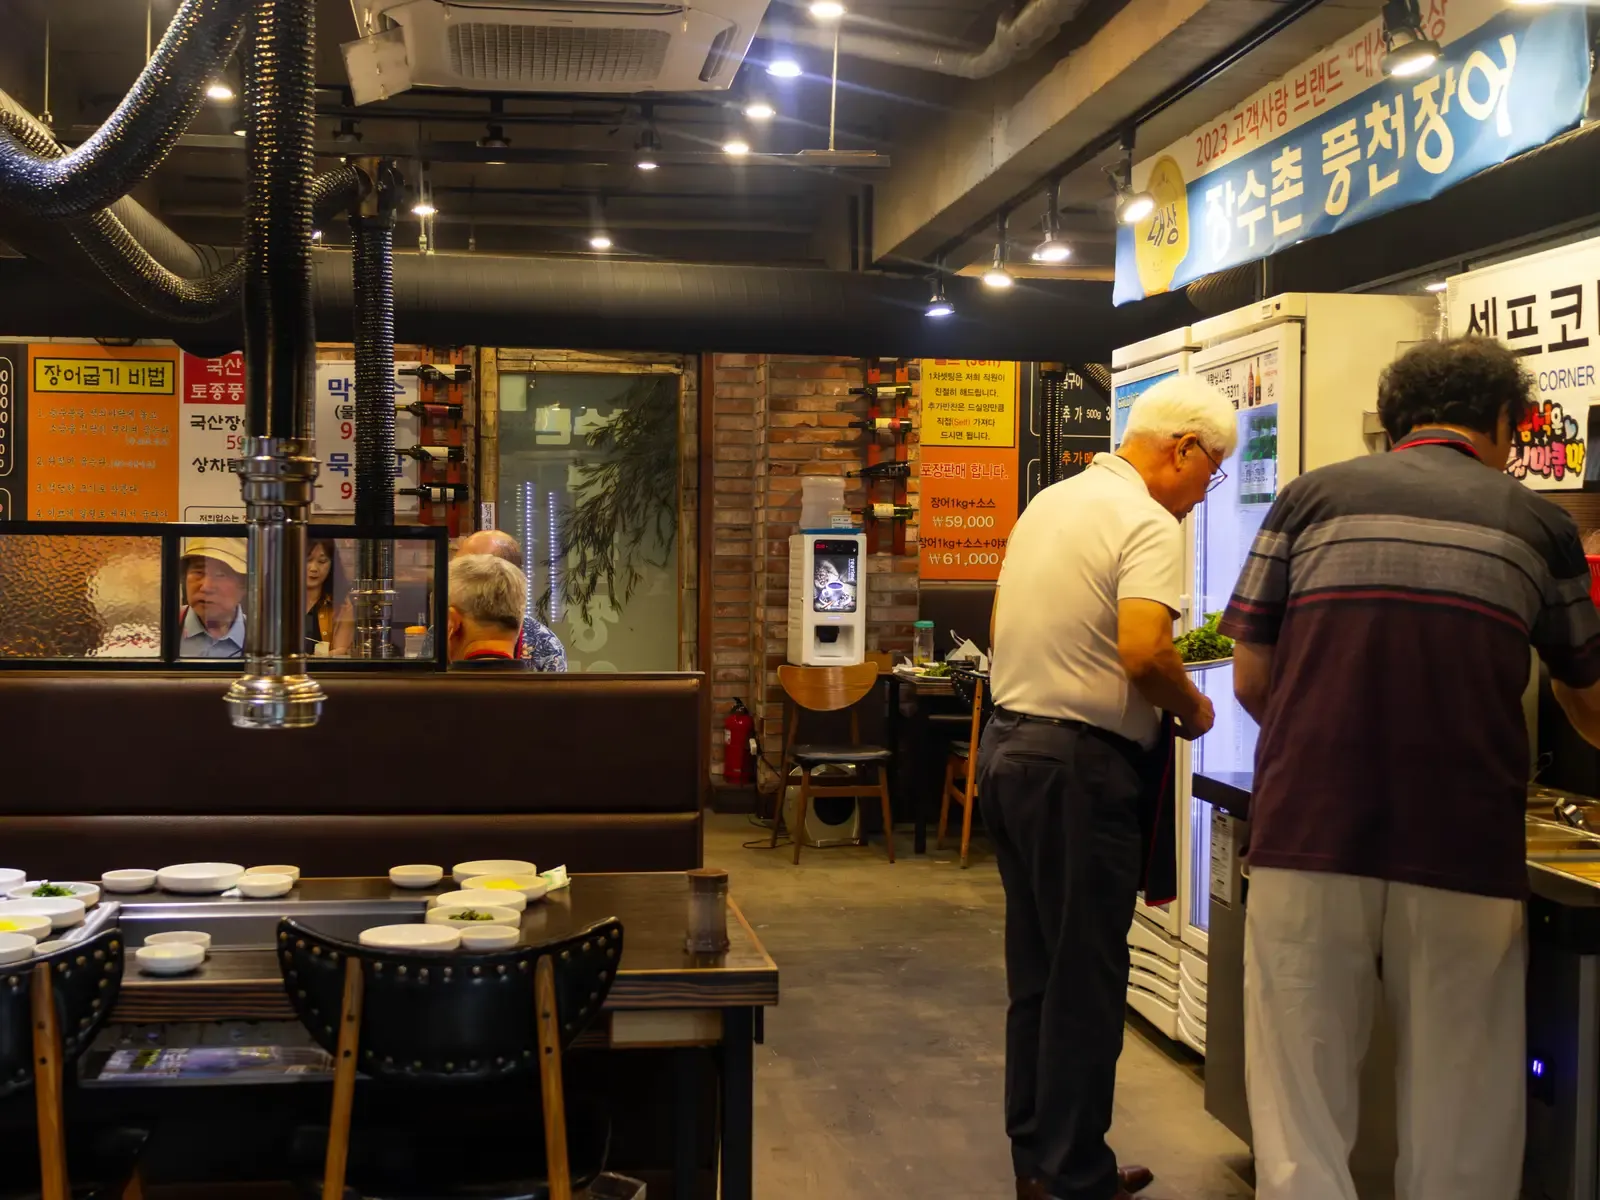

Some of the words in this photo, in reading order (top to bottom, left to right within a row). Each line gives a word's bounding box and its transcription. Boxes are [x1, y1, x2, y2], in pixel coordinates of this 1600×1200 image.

[1196, 129, 1228, 168] 2023
[1231, 90, 1289, 145] 고객사랑
[1293, 54, 1344, 112] 브랜드
[1205, 144, 1305, 263] 장수촌
[1321, 34, 1518, 217] 풍천장어
[1146, 202, 1179, 247] 대상
[43, 364, 120, 387] 장어굽기
[128, 366, 165, 388] 비법
[1539, 365, 1595, 392] CORNER
[190, 382, 245, 401] 토종풍
[190, 415, 246, 431] 국산장
[1086, 409, 1101, 420] 500g
[920, 463, 966, 478] 포장판매
[971, 463, 1009, 479] 합니다.
[931, 497, 996, 509] 장어1kg+소스
[933, 515, 994, 529] ₩59,000
[929, 552, 999, 566] ₩61,000
